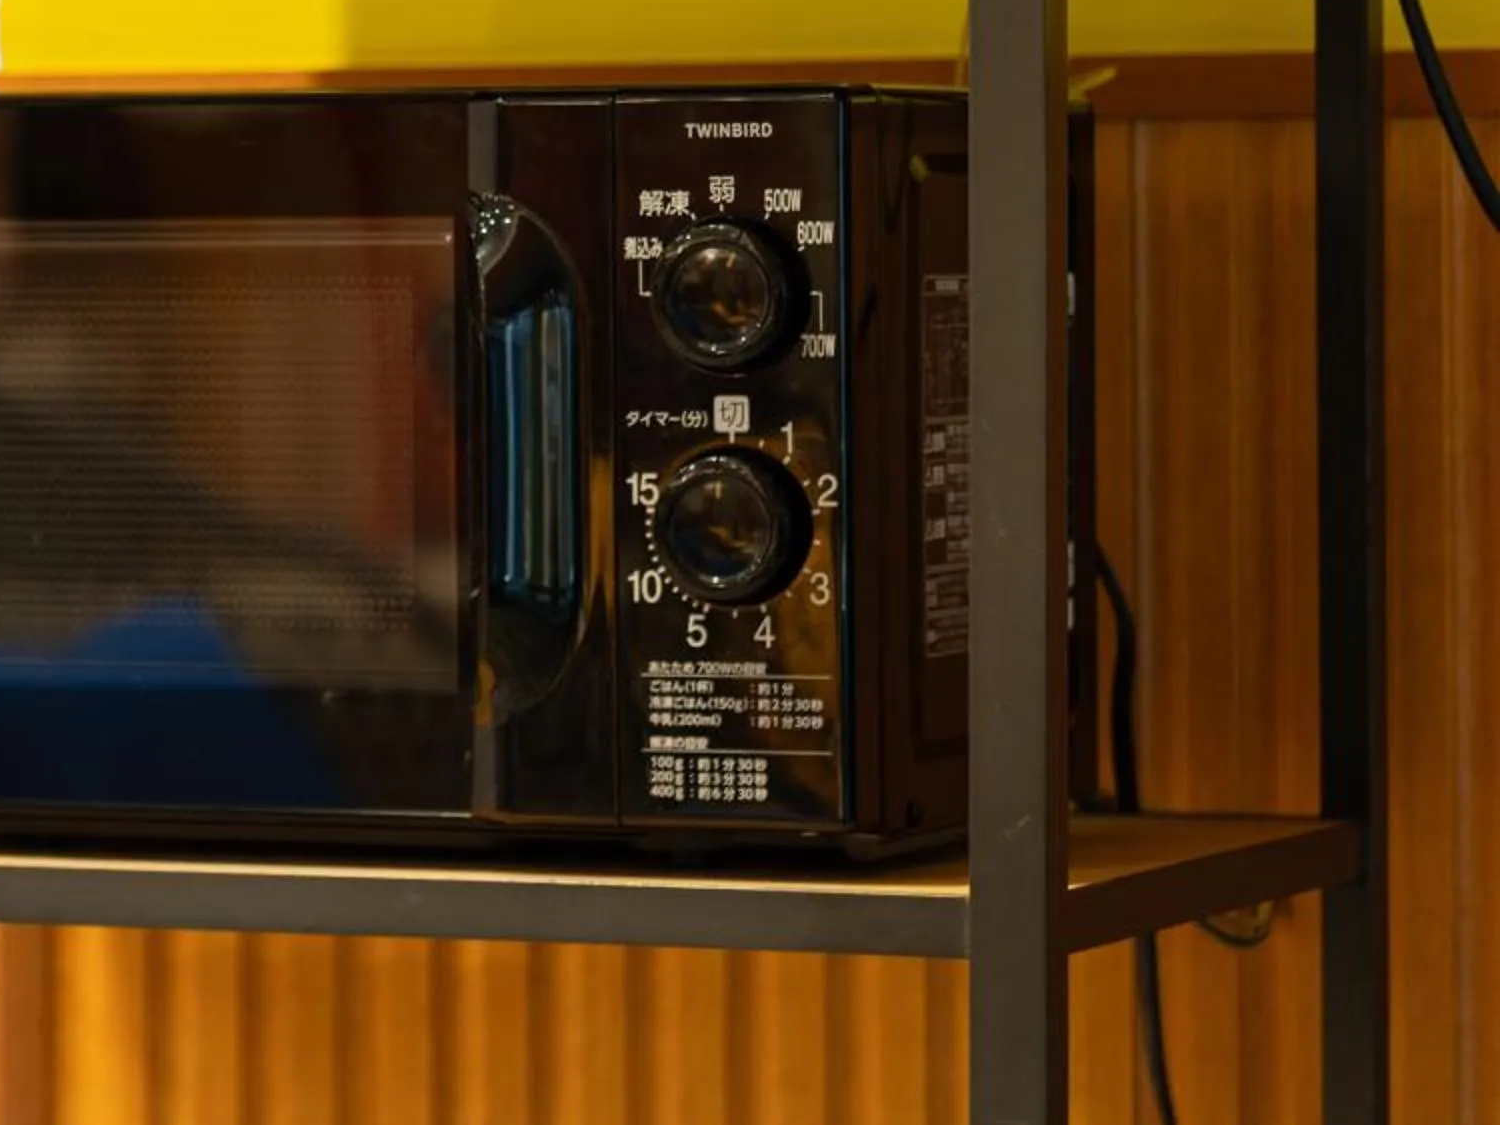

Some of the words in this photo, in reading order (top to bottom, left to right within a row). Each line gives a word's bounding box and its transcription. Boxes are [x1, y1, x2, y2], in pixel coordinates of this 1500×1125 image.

[685, 123, 774, 138] TWINBIRD
[639, 190, 691, 217] 解凍
[708, 176, 736, 204] 弱
[764, 189, 803, 213] 500W
[800, 334, 836, 358] 700W
[721, 402, 746, 429] 切
[780, 421, 794, 454] 1
[626, 473, 660, 506] 15
[817, 474, 839, 507] 2
[627, 571, 662, 604] 10
[809, 573, 831, 606] 3
[686, 615, 708, 648] 5
[753, 616, 776, 649] 4
